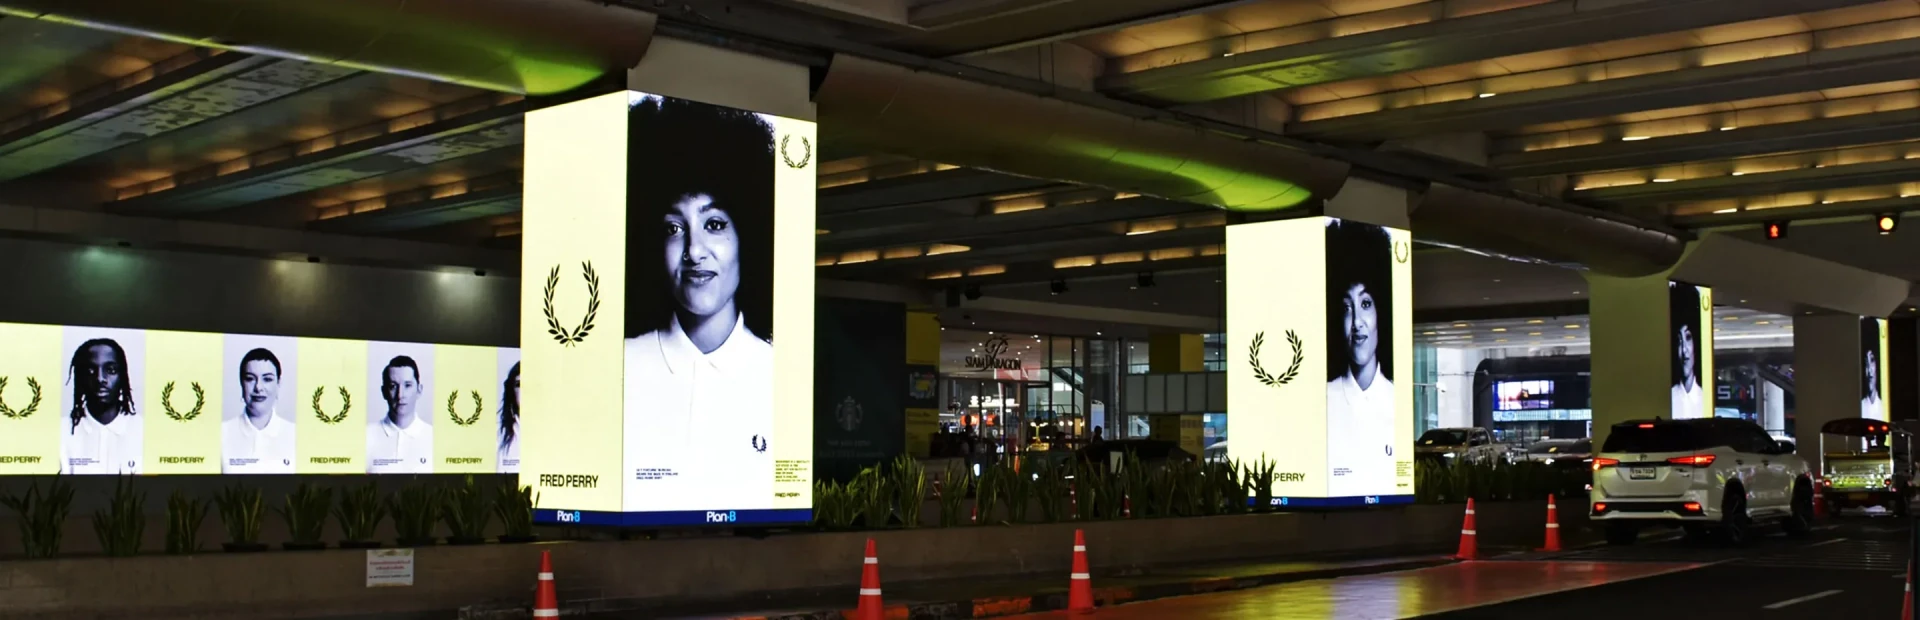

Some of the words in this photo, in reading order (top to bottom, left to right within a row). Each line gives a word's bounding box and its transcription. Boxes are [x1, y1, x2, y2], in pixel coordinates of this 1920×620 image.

[965, 356, 984, 368] SIAM
[984, 354, 1021, 370] PARAGON
[14, 456, 42, 464] PERRY
[159, 456, 179, 464] FRED
[180, 456, 205, 464] PERRY
[540, 474, 565, 488] FRED
[566, 474, 599, 489] PERRY
[1273, 472, 1305, 482] PERRY
